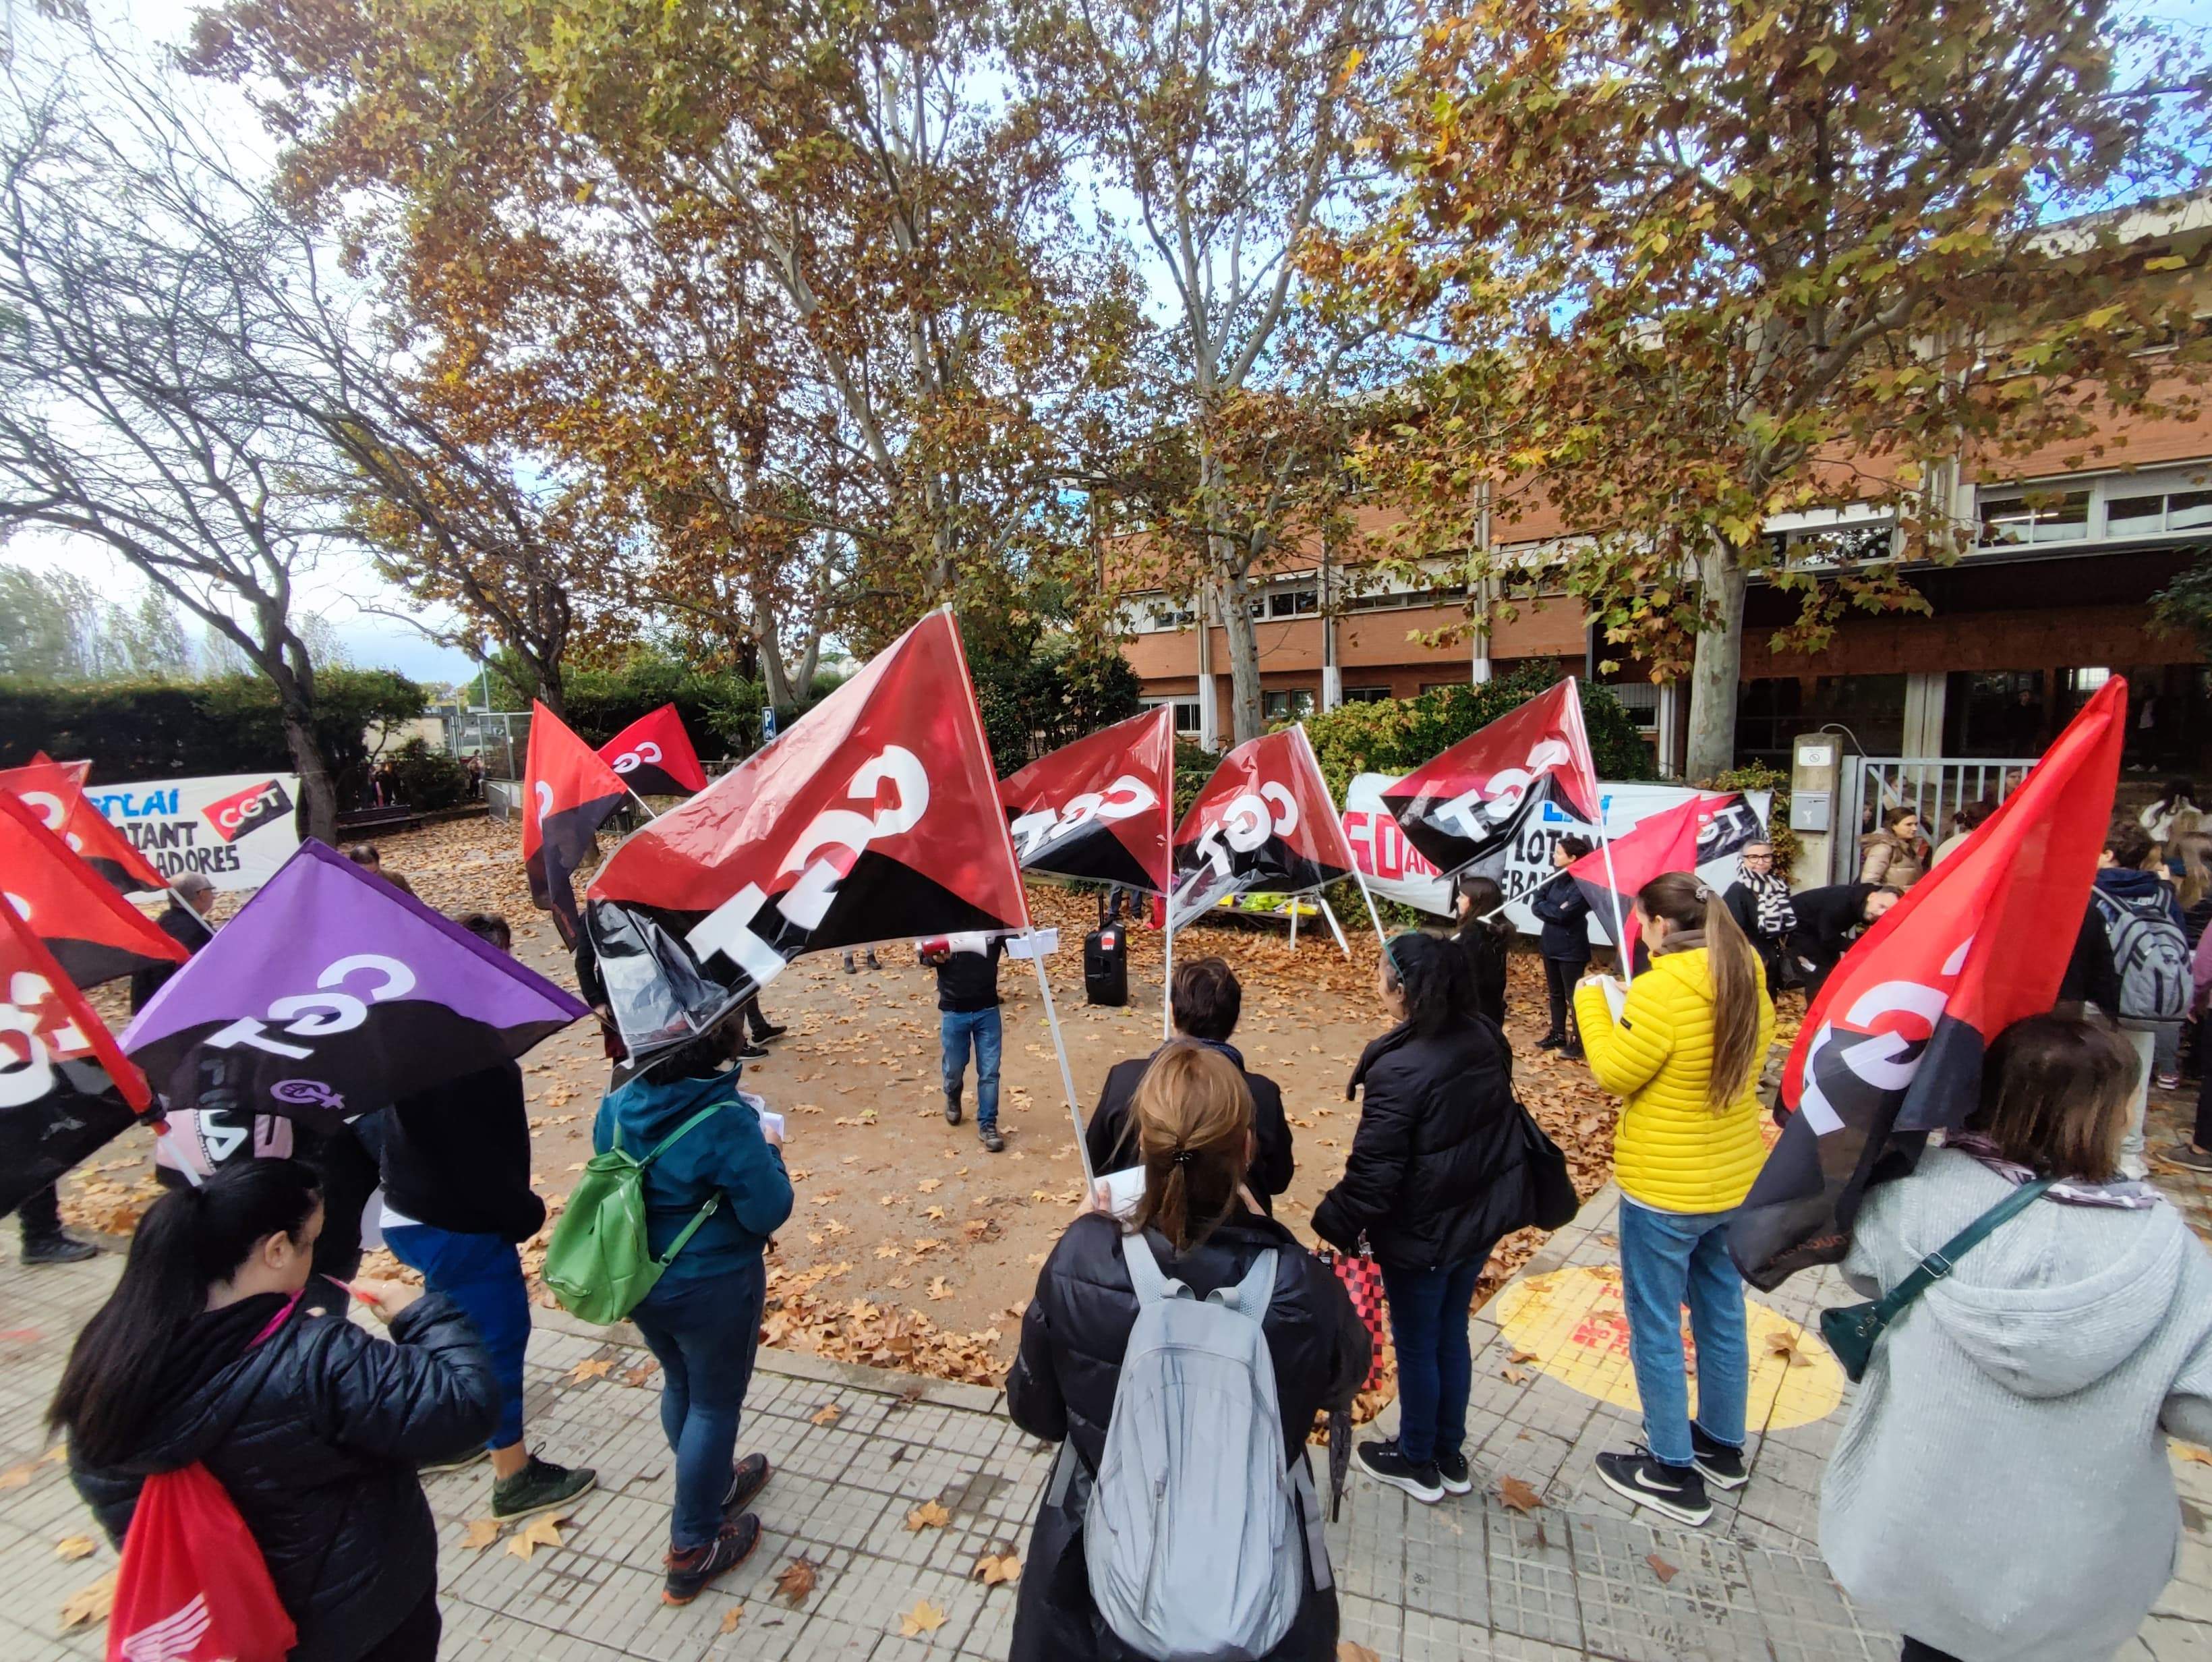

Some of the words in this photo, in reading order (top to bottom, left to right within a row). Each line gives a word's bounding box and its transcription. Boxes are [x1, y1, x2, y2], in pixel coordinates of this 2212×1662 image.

[764, 710, 772, 727] P
[220, 788, 279, 828] CGT
[116, 822, 198, 849] TANT
[141, 844, 240, 878] ADORES
